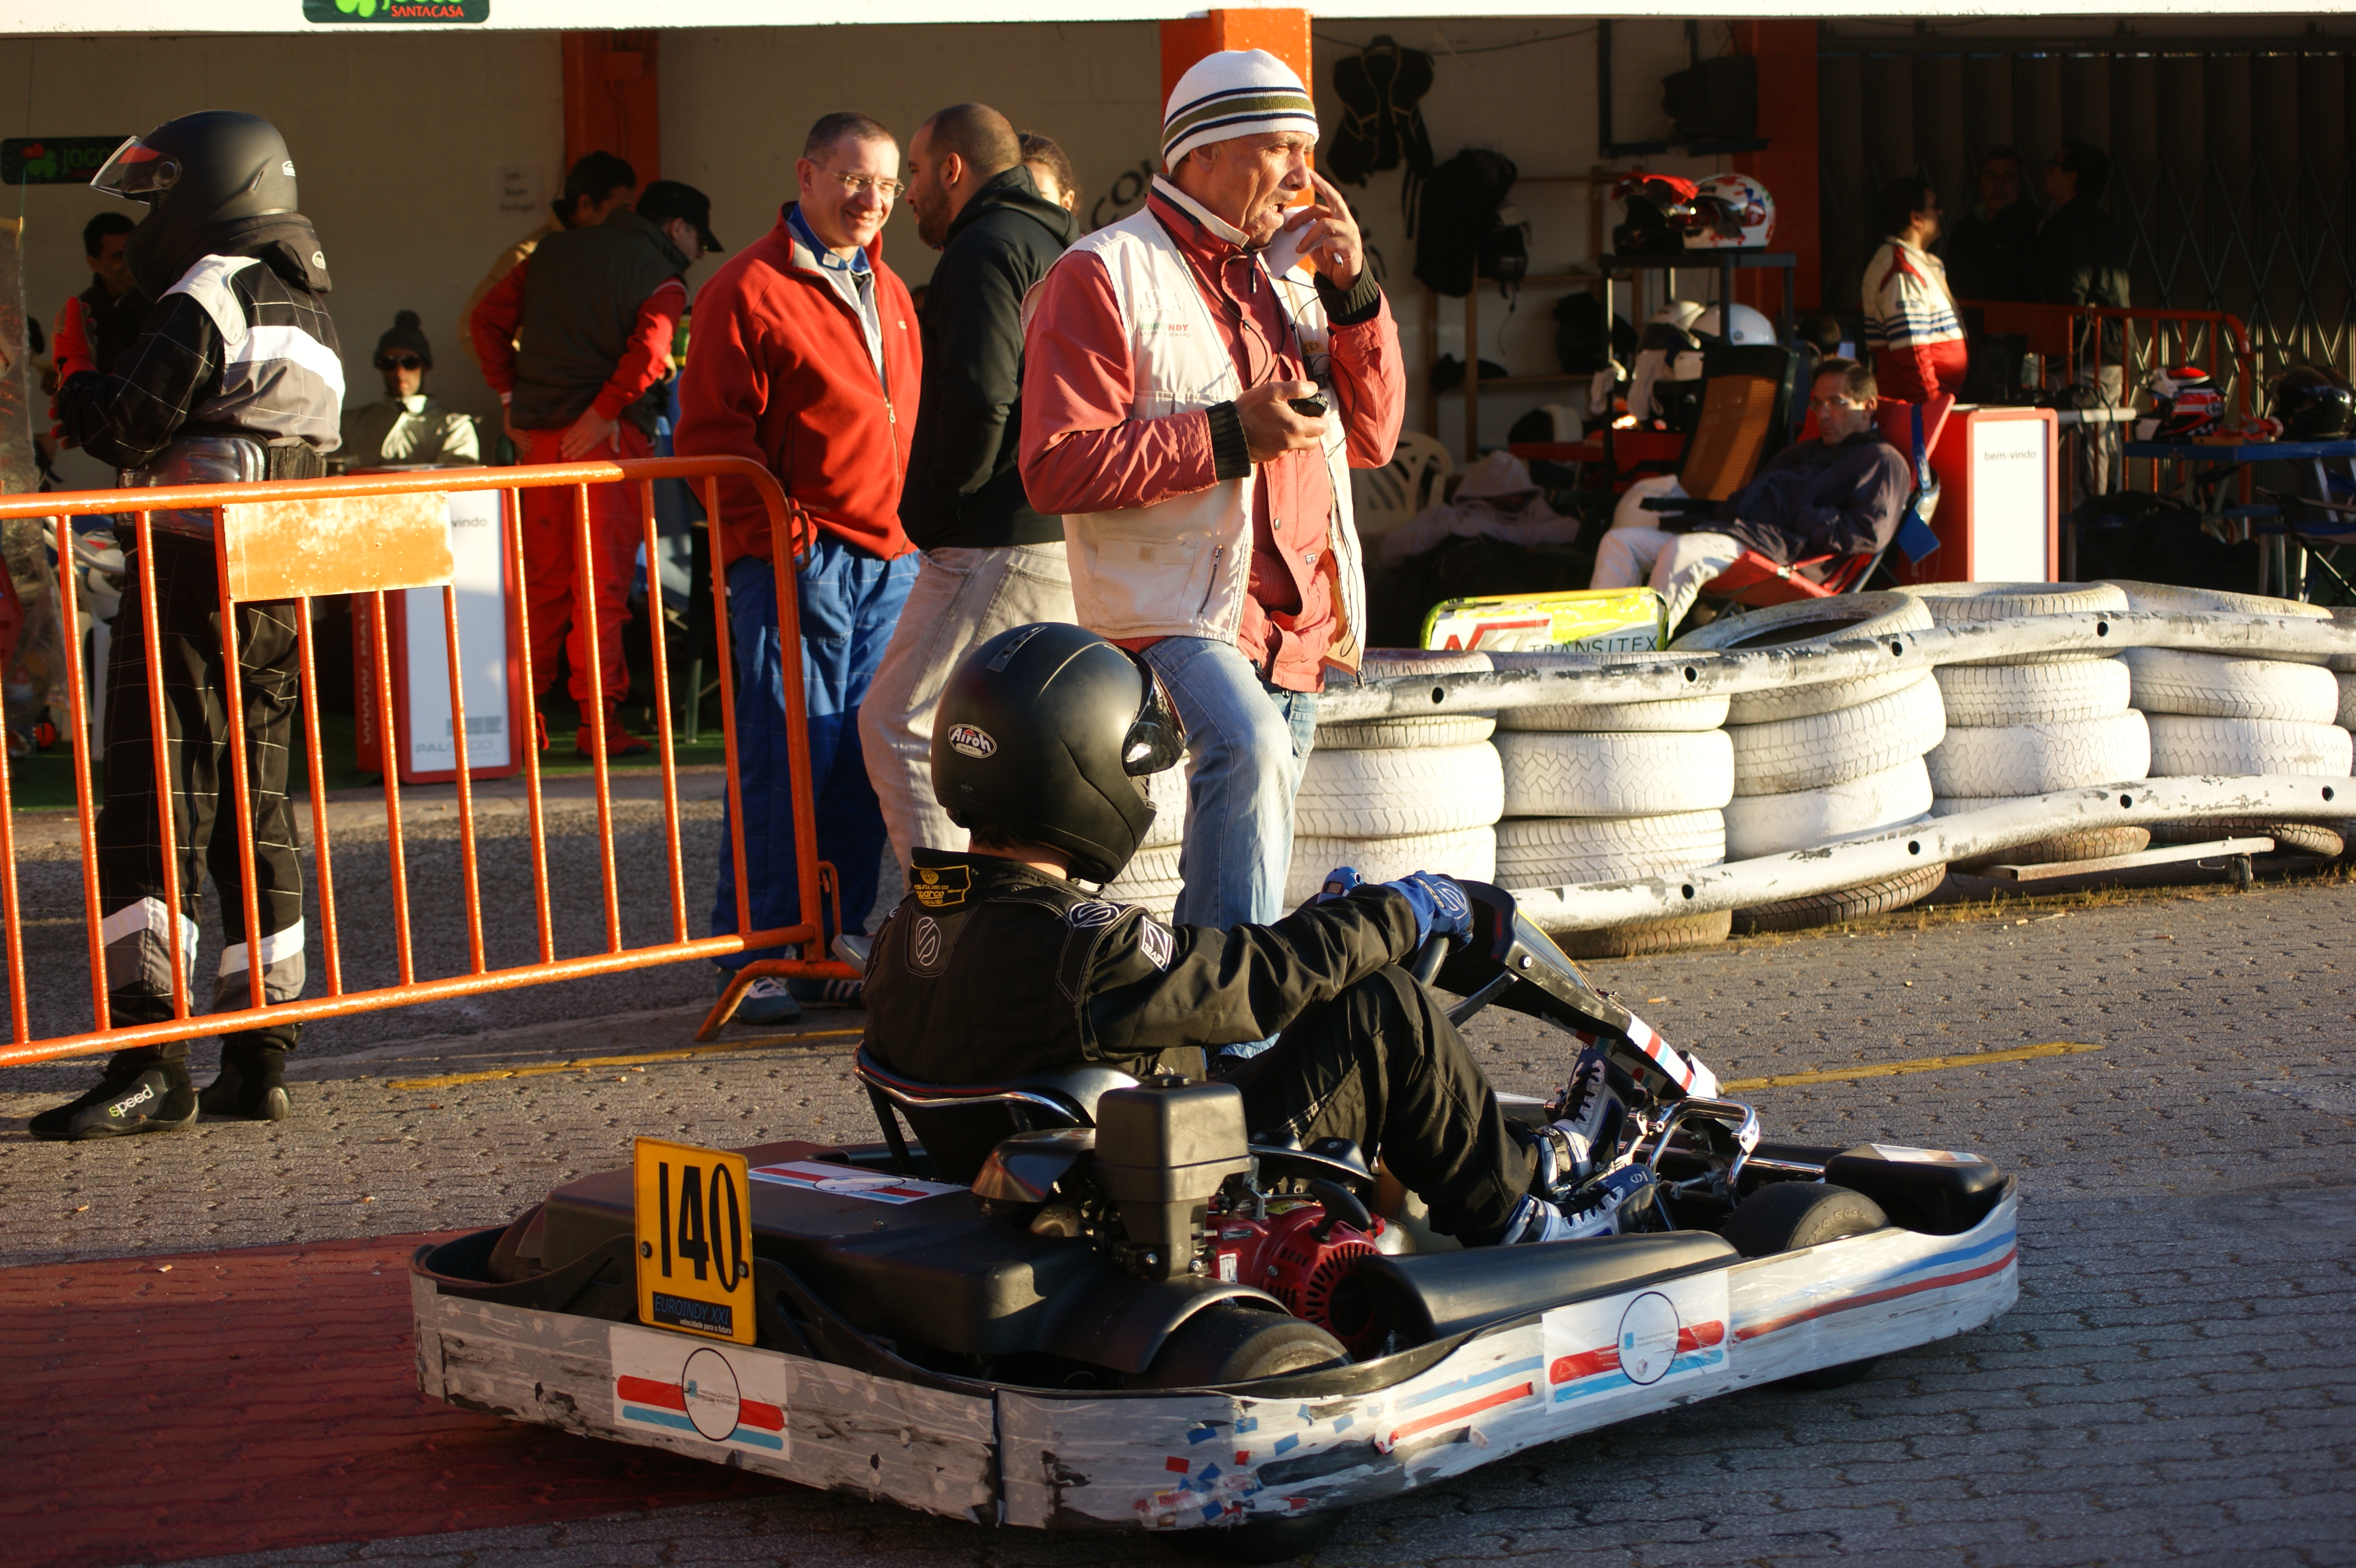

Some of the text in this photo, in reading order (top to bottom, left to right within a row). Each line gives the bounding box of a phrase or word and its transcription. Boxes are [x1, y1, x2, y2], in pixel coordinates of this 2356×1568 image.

[390, 6, 464, 17] SANTACASA
[1984, 449, 2036, 461] bem-vindo
[451, 516, 487, 527] vindo
[951, 728, 991, 752] Airoh
[1144, 942, 1166, 967] LEVEL
[108, 1084, 154, 1118] speed
[659, 1162, 742, 1293] 140
[655, 1296, 730, 1325] EUROINDY XXI
[680, 1318, 703, 1329] velocidade
[718, 1325, 732, 1335] futuro
